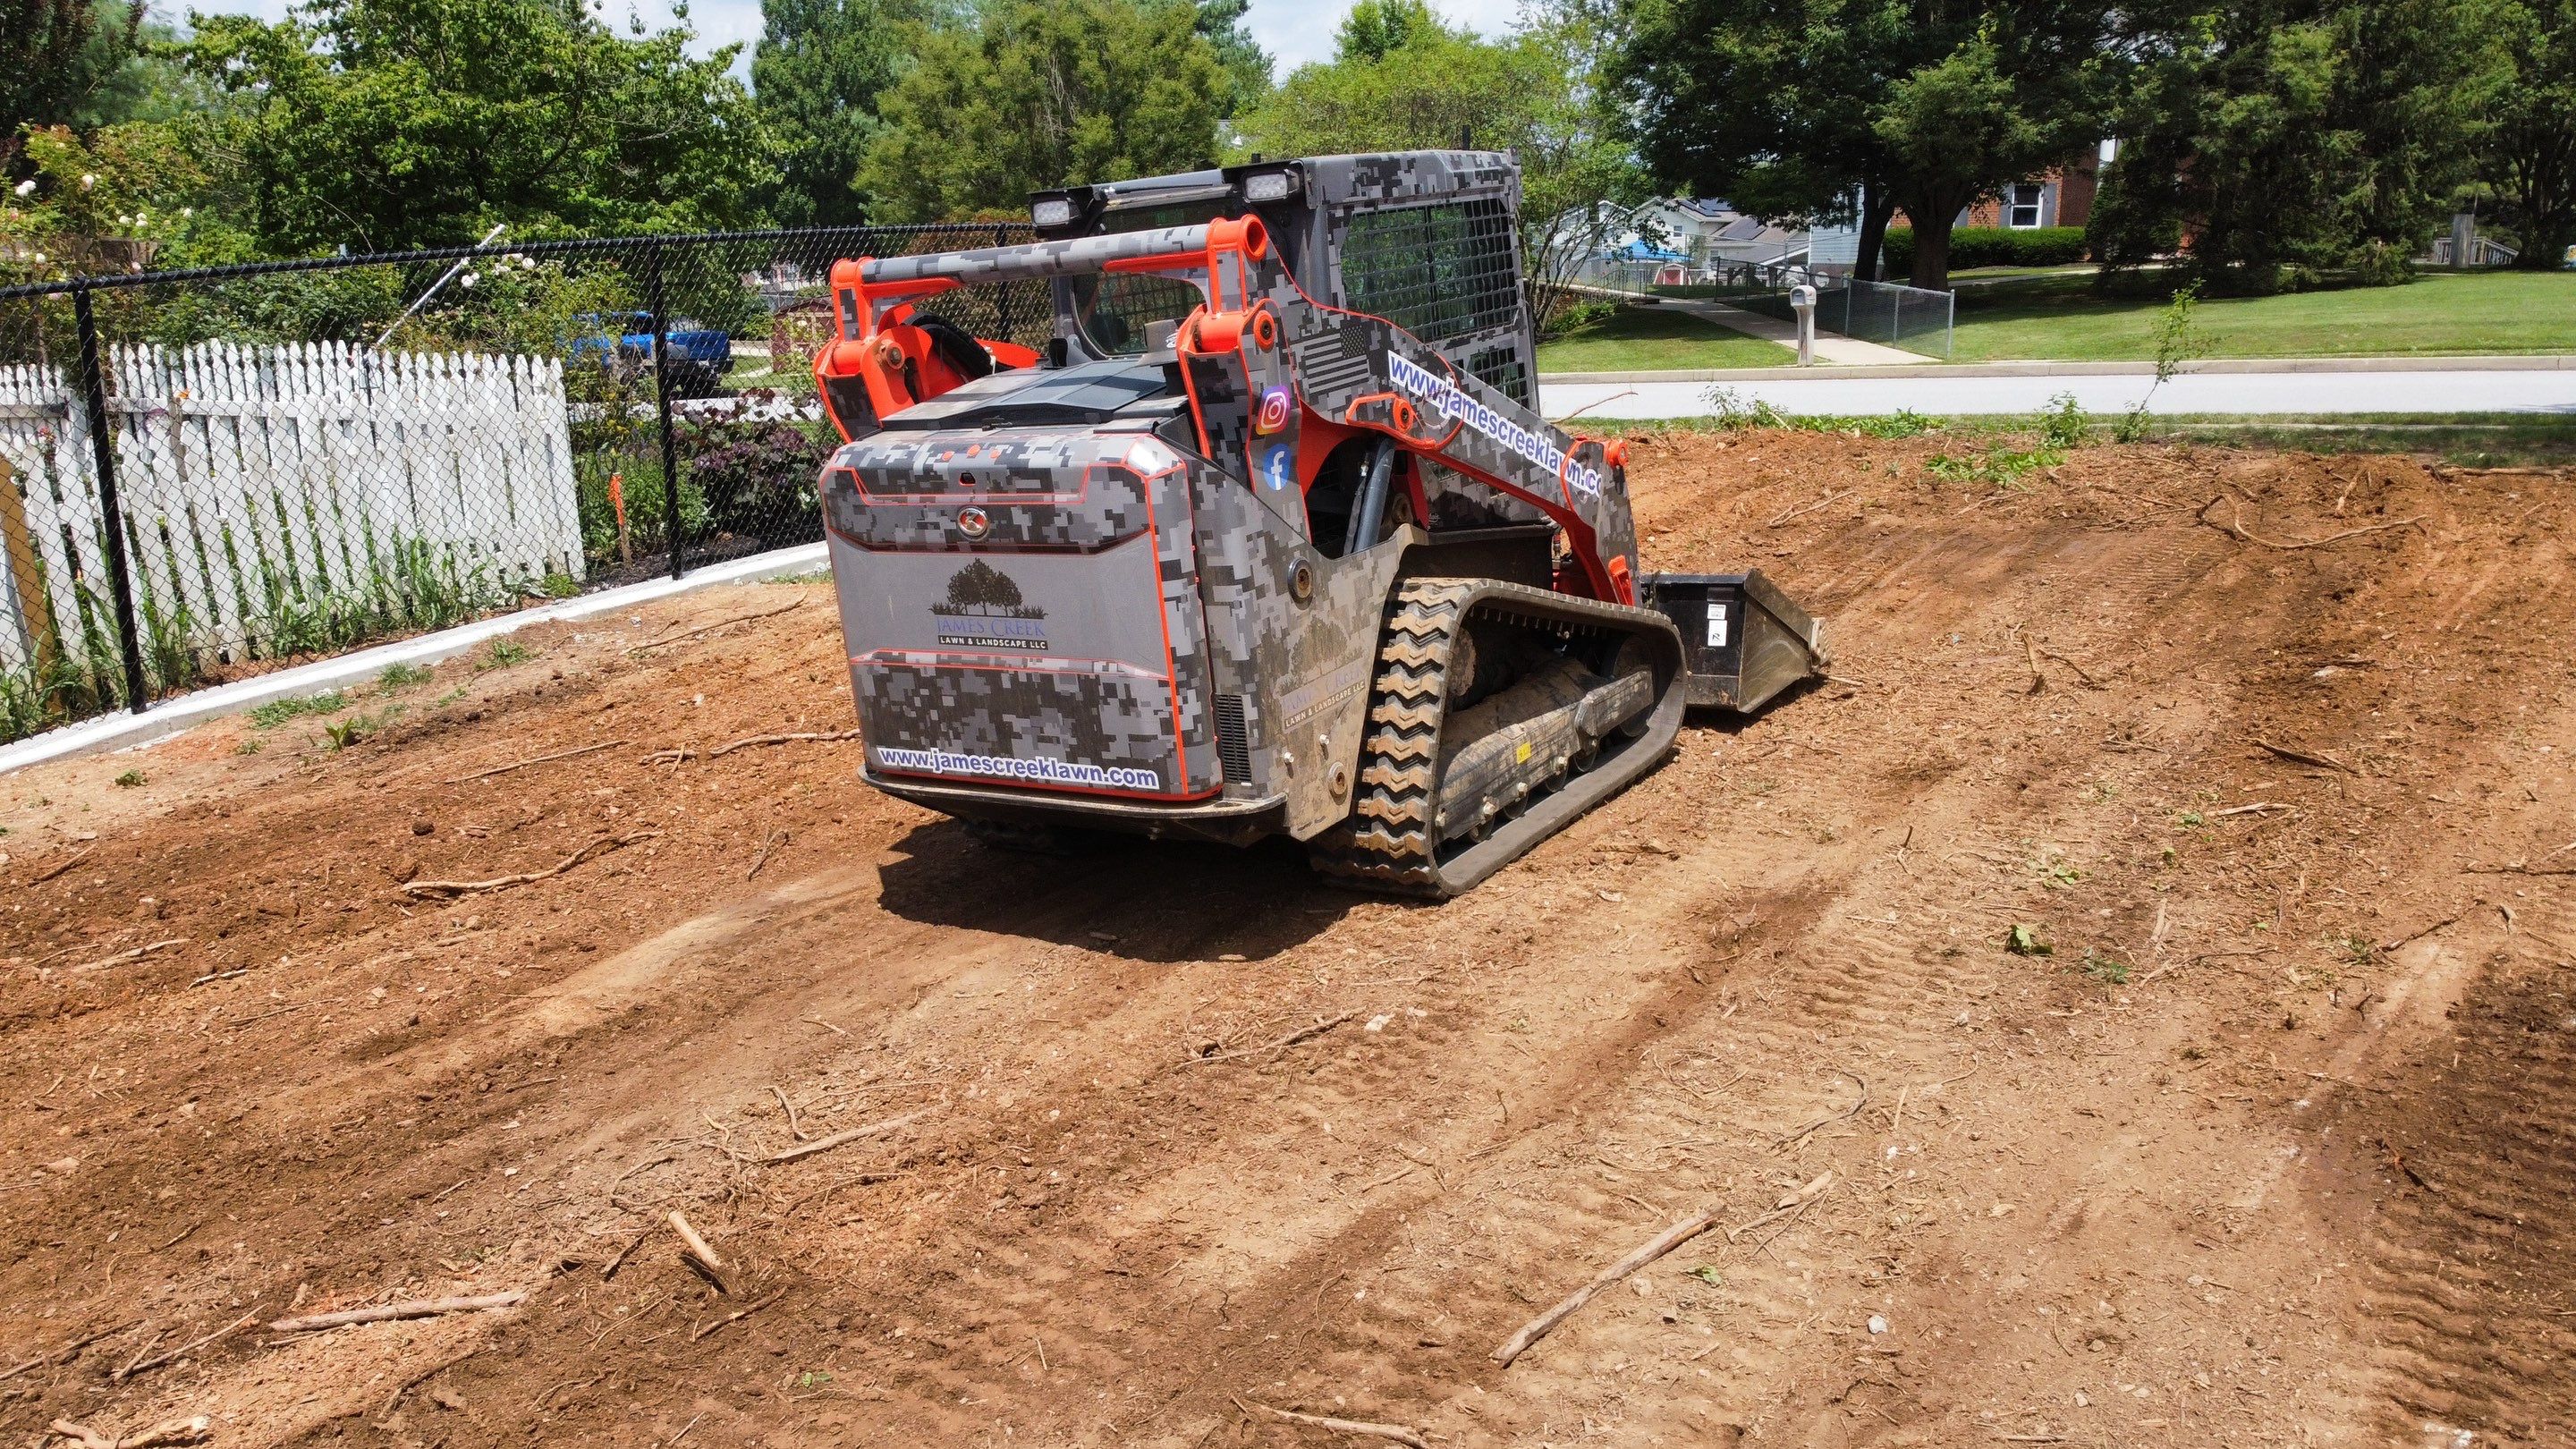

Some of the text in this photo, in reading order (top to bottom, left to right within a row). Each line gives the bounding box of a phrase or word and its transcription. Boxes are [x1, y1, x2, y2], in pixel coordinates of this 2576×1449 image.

[936, 616, 1046, 637] JAMES CREEK
[940, 636, 965, 645] LAWN
[976, 638, 1028, 648] LANDSCAPE
[1030, 640, 1046, 649] LLC
[1285, 711, 1307, 727] LAWN
[1314, 687, 1352, 713] LANDSCAPE
[1353, 681, 1365, 692] LLC
[880, 748, 1157, 787] www.jamescreeklawn.com
